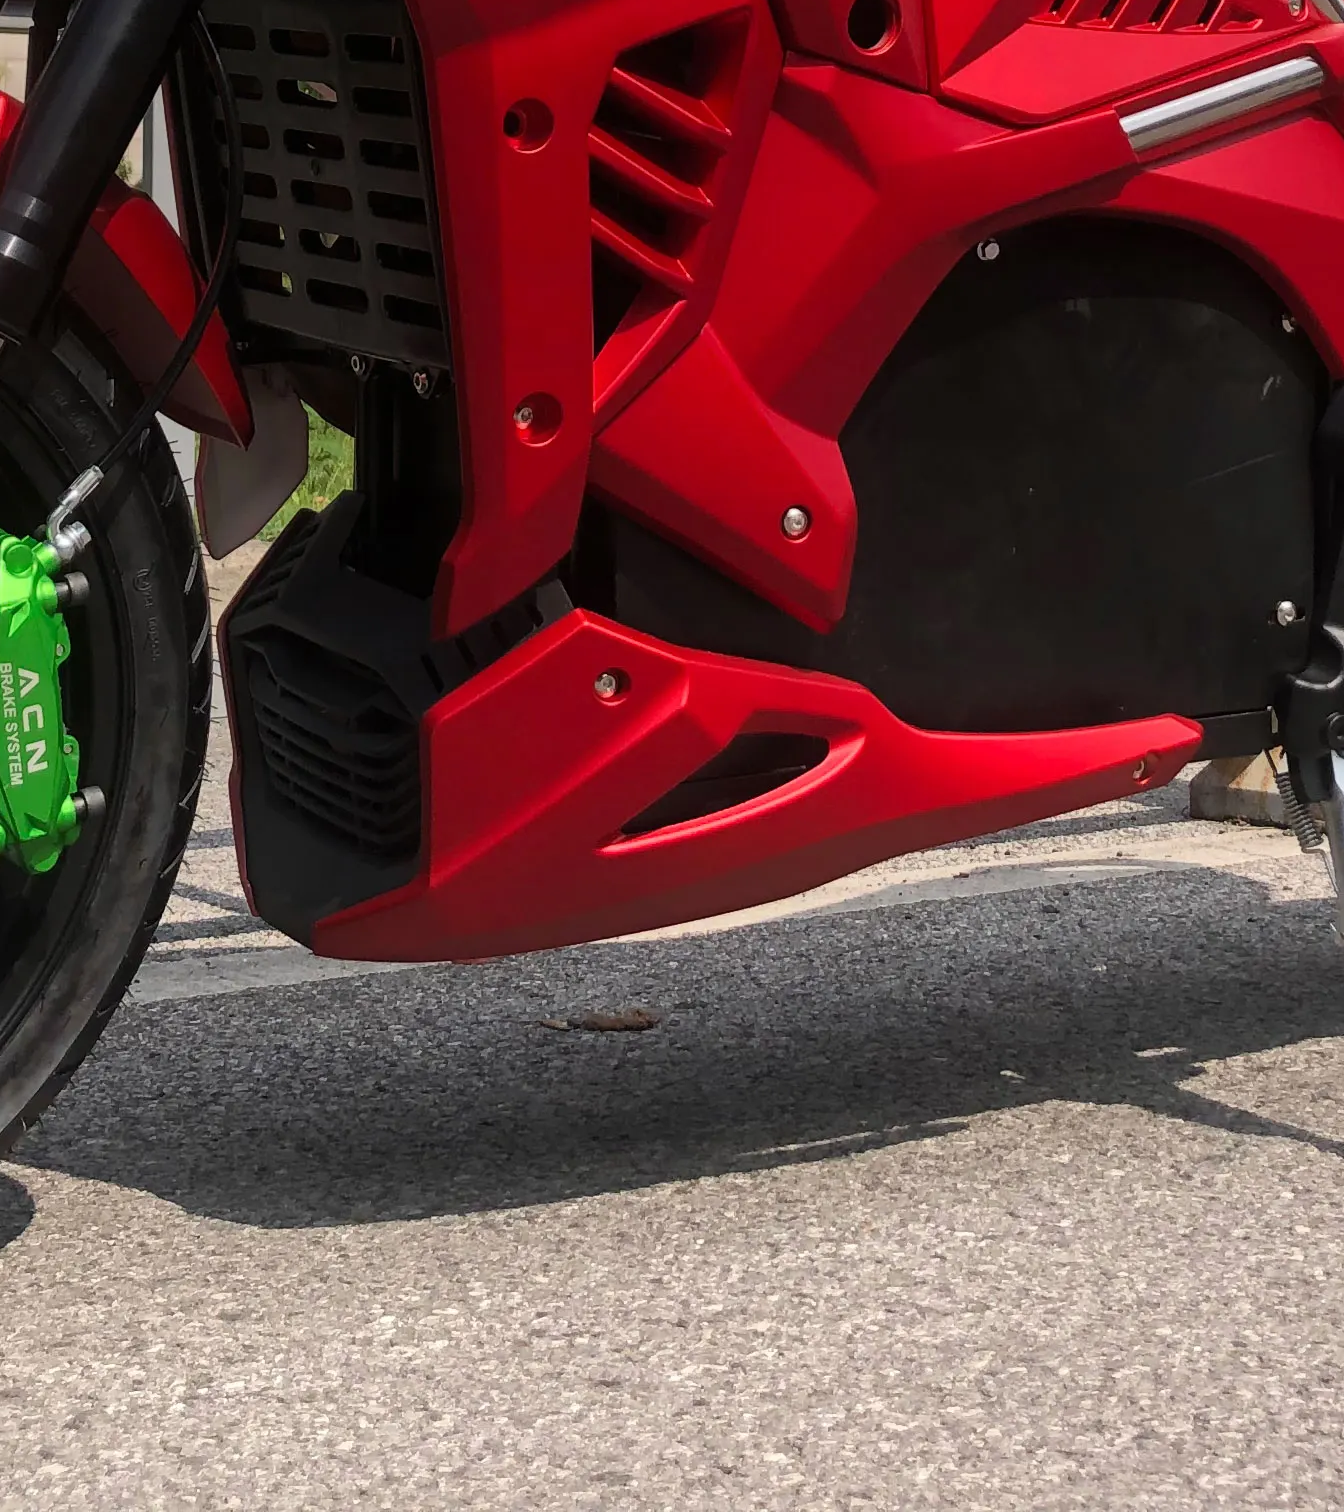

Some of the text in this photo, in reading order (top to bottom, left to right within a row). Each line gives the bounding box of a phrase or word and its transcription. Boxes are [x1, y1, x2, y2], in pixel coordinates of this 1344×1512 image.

[0, 662, 24, 786] BRAKE SYSTEM
[17, 667, 49, 774] ACN
